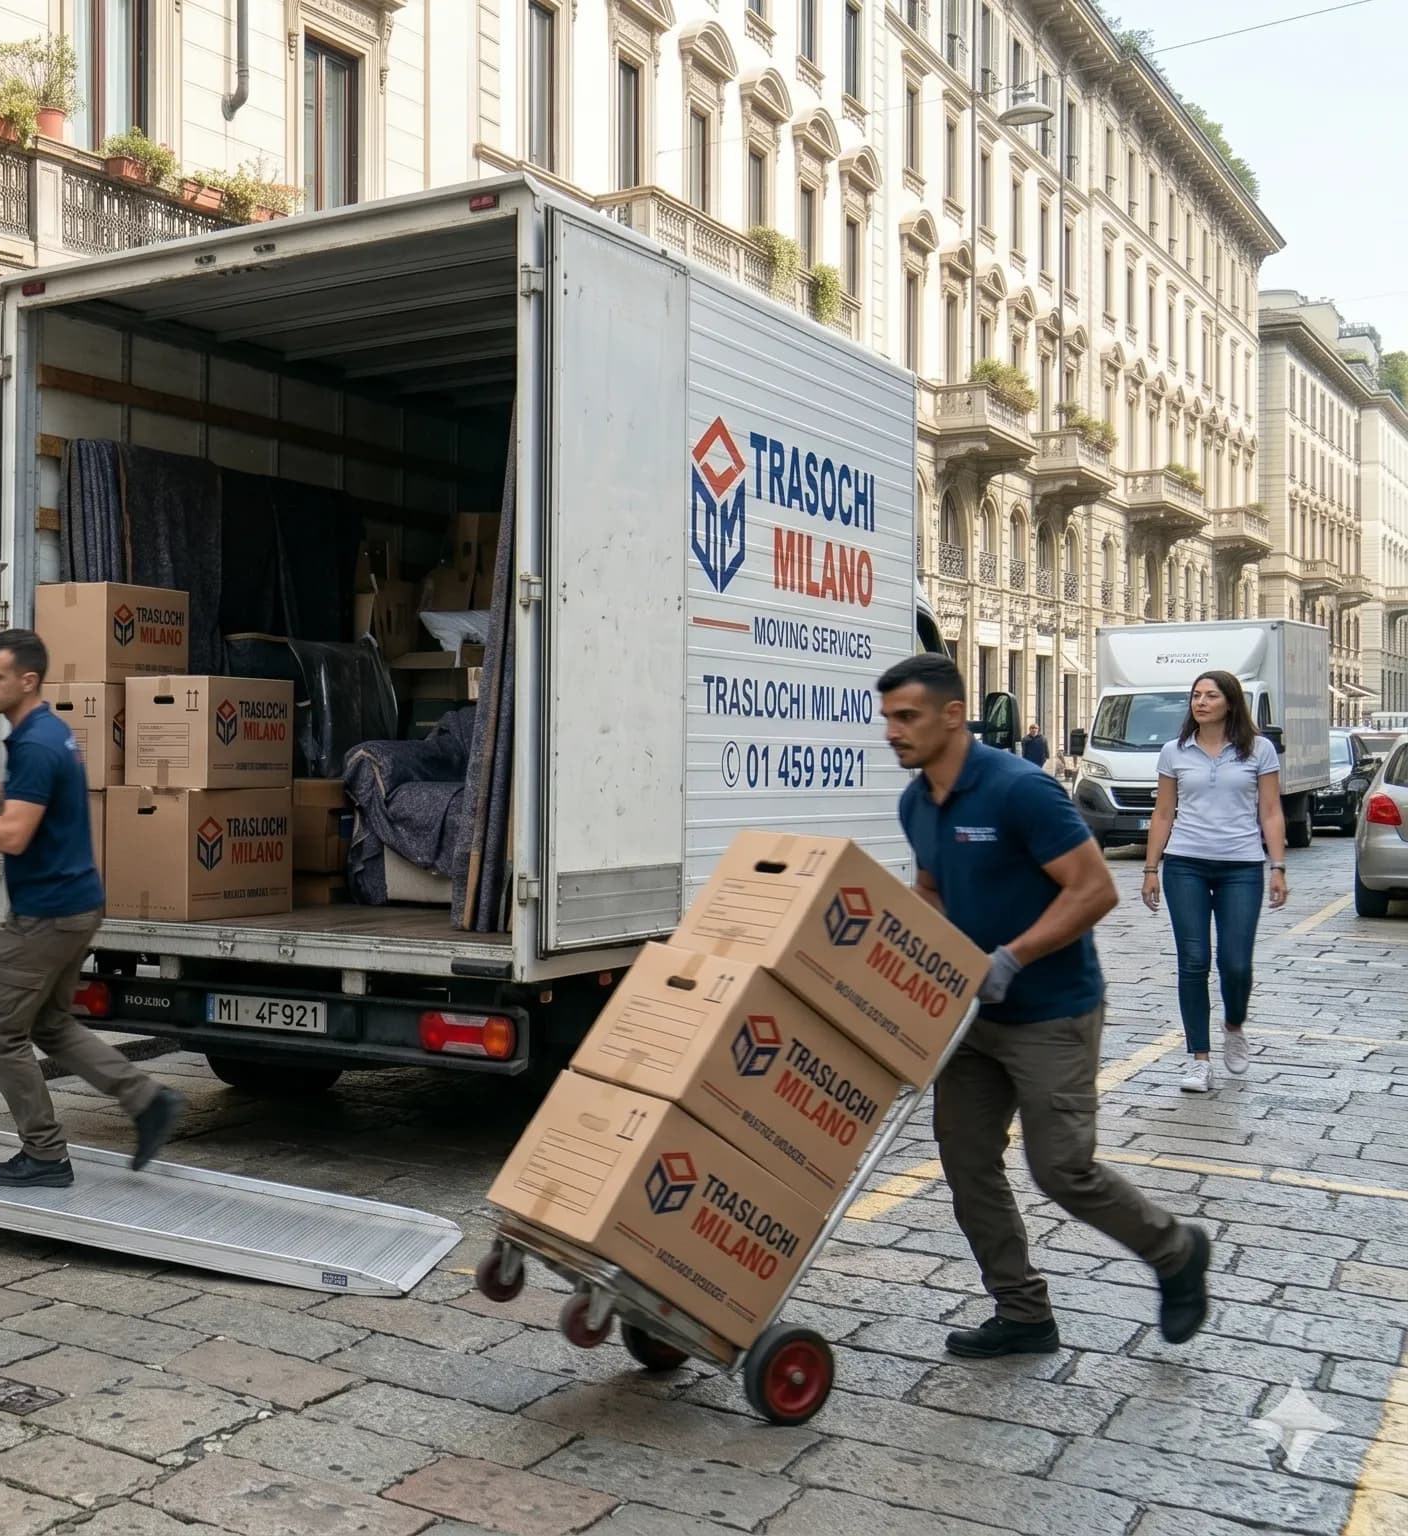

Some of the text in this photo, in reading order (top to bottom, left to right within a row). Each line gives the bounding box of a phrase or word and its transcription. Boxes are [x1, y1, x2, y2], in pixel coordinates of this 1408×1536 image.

[750, 431, 875, 532] TRASOCHI
[774, 527, 873, 608] MILANO
[136, 607, 185, 626] TRASLOCHI
[140, 626, 182, 646] MILANO
[754, 616, 872, 660] MOVING SERVICES
[703, 674, 873, 724] TRASLOCHI MILANO
[243, 721, 286, 741] MILANO
[746, 743, 865, 788] 01 459 9921
[226, 816, 287, 837] TRASLOCHI
[231, 840, 283, 865] MILANO
[875, 909, 969, 998] TRASLOCHI
[865, 942, 948, 1018] MILANO
[218, 998, 317, 1028] MI 4F921
[784, 1038, 879, 1125] TRASLOCHI
[773, 1070, 858, 1147] MILANO
[700, 1173, 800, 1258] TRASLOCHI
[690, 1206, 779, 1281] MILANO
